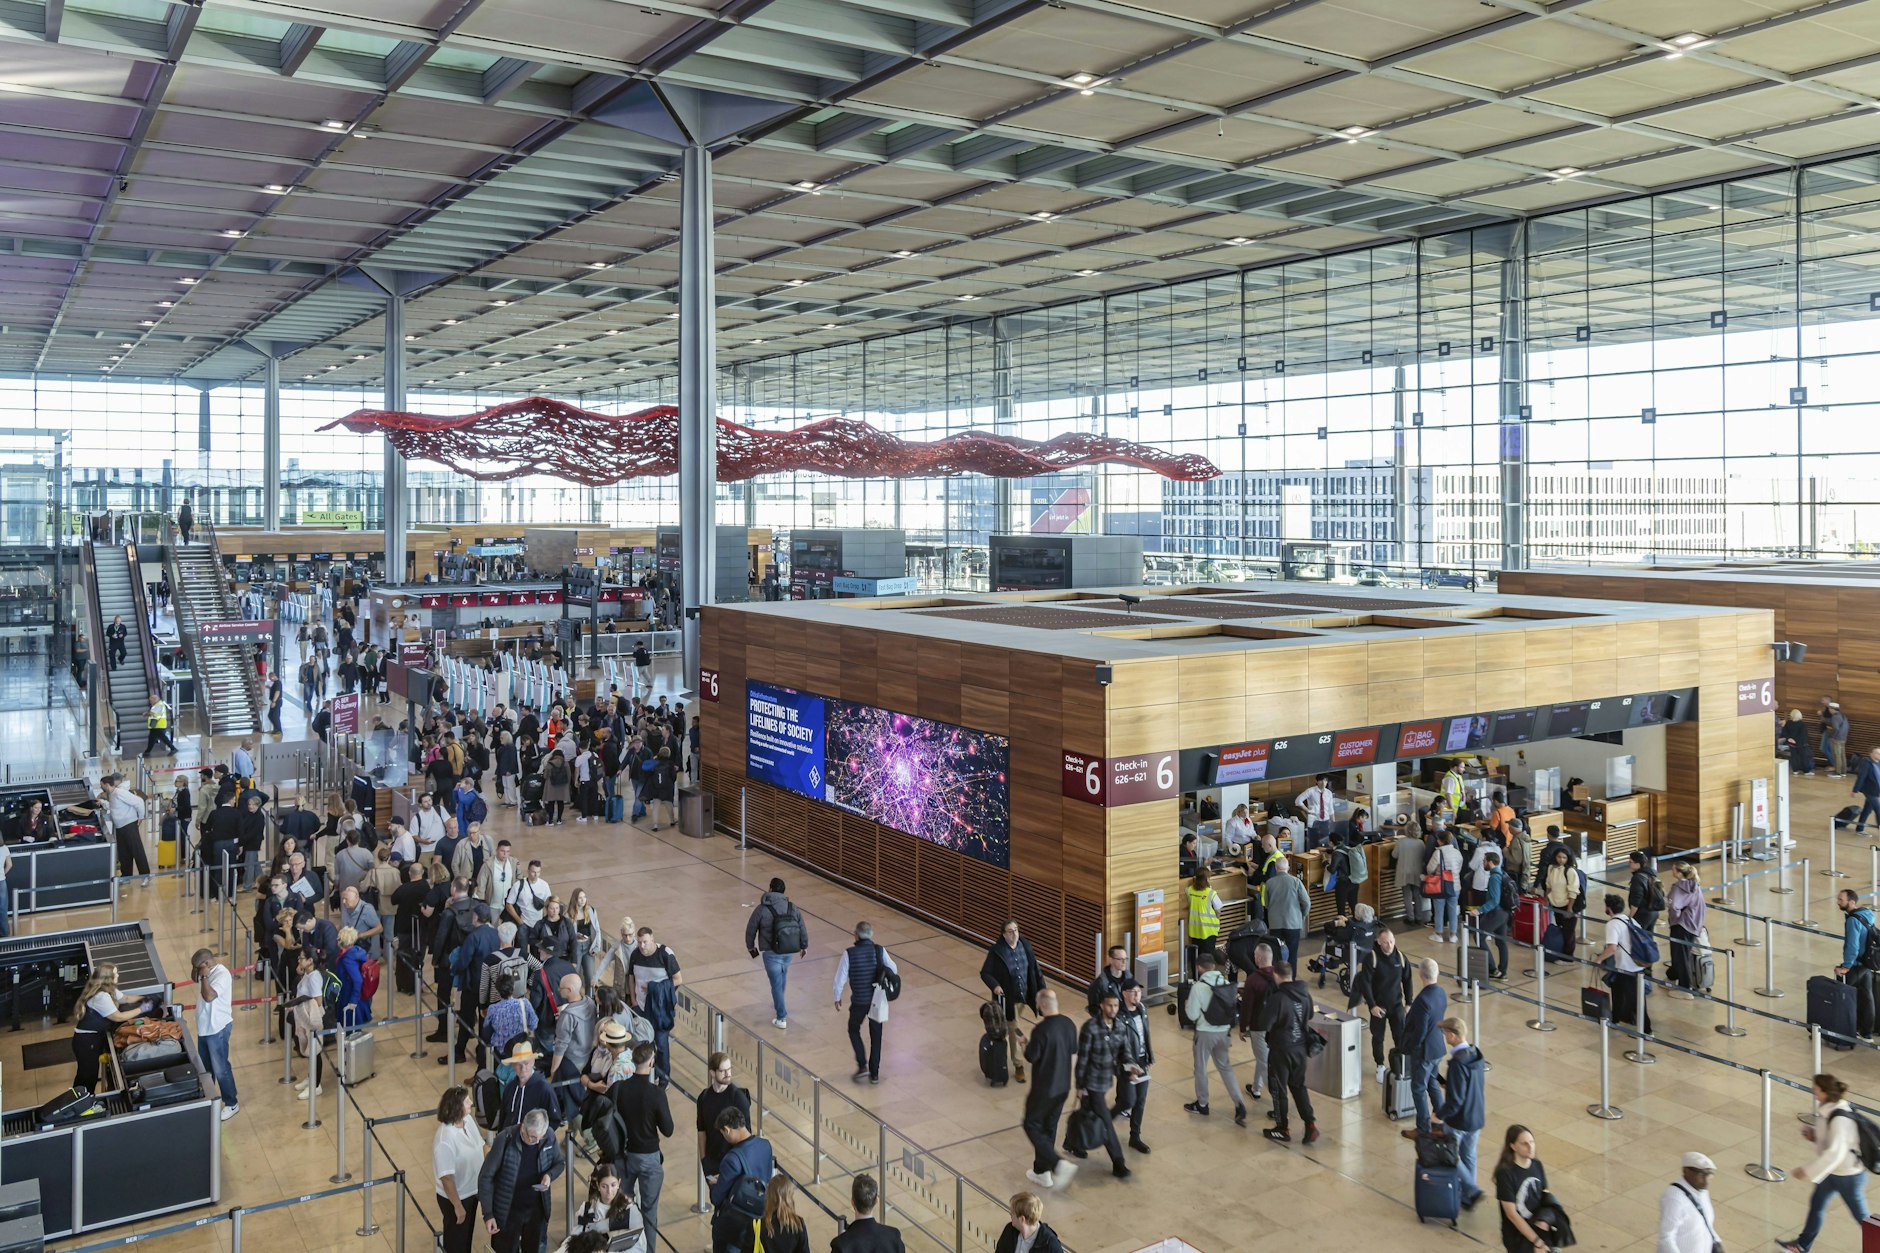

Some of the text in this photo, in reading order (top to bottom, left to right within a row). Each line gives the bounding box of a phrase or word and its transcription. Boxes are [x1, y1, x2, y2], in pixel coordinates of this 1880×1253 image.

[335, 512, 358, 520] Gates
[711, 674, 718, 696] 6
[1739, 682, 1771, 706] Check-in 6
[750, 698, 798, 722] PROTECTING THE
[750, 713, 813, 742] LIFELINES OF SOCIETY
[1417, 730, 1432, 739] BAG
[750, 729, 766, 740] Resilience
[780, 738, 796, 749] innovative
[797, 744, 813, 754] solutions
[1275, 735, 1331, 750] 626 625
[1339, 739, 1373, 750] CUSTOMER
[1416, 738, 1435, 748] DROP
[1223, 748, 1266, 760] easyJet plus
[1338, 747, 1363, 757] SERVICE
[1065, 755, 1100, 795] Check-in 6
[1115, 756, 1173, 789] Check-in 6
